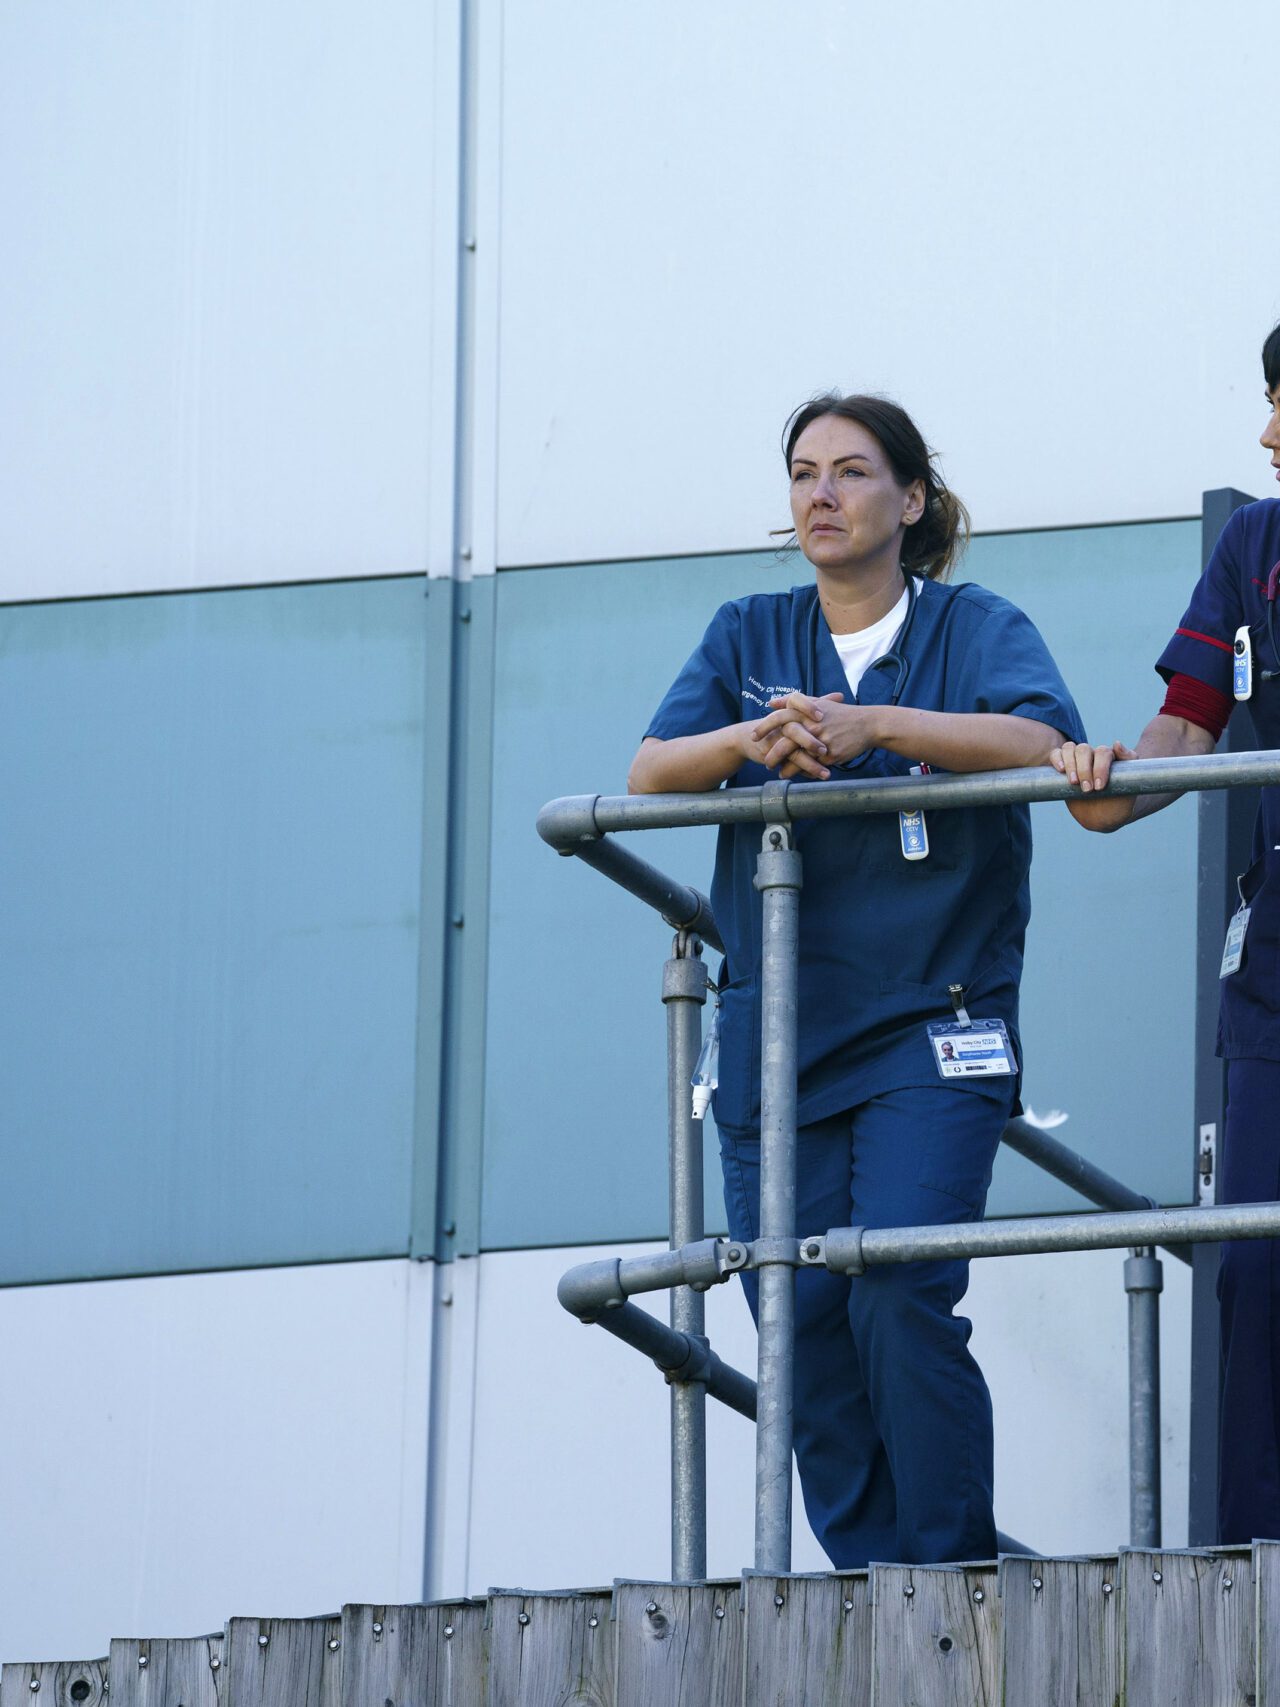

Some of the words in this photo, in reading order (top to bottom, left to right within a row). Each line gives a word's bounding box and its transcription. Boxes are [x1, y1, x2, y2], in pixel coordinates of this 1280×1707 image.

[748, 676, 765, 691] Holby
[775, 685, 801, 694] Hospital
[741, 690, 764, 706] rgency
[903, 818, 920, 827] NHS
